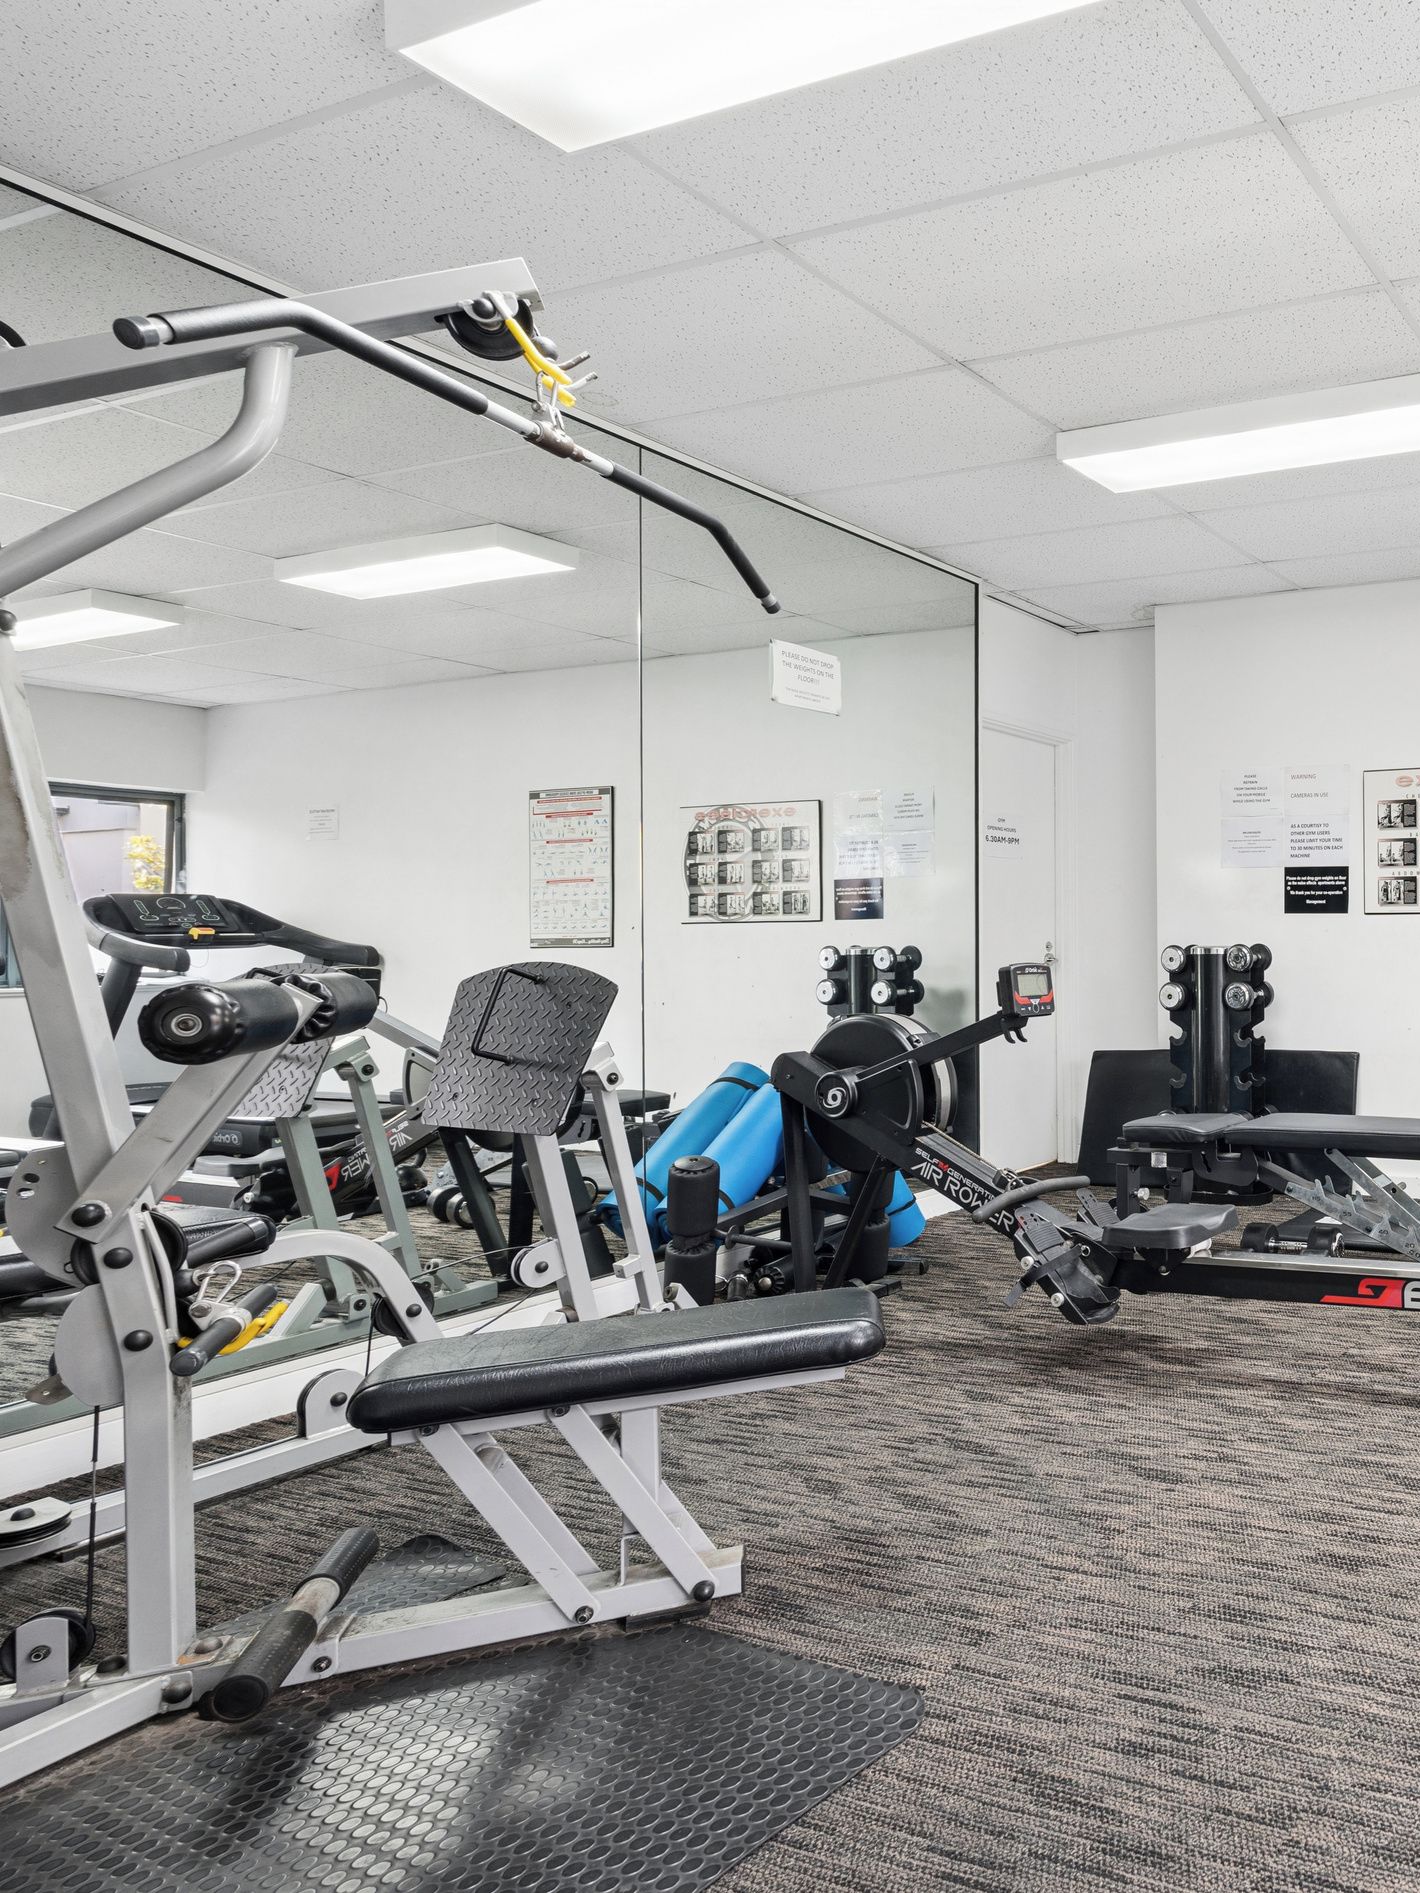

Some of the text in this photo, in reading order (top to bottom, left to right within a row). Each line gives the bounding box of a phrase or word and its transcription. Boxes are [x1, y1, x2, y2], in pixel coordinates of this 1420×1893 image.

[782, 651, 801, 660] PLEASE
[801, 655, 809, 663] DO
[821, 661, 834, 669] DROP
[782, 660, 792, 668] THE
[794, 663, 816, 674] WEIGHTS
[986, 835, 1020, 845] 6.30AM-9PM
[915, 1148, 939, 1165] SELF
[911, 1161, 944, 1186] AIR
